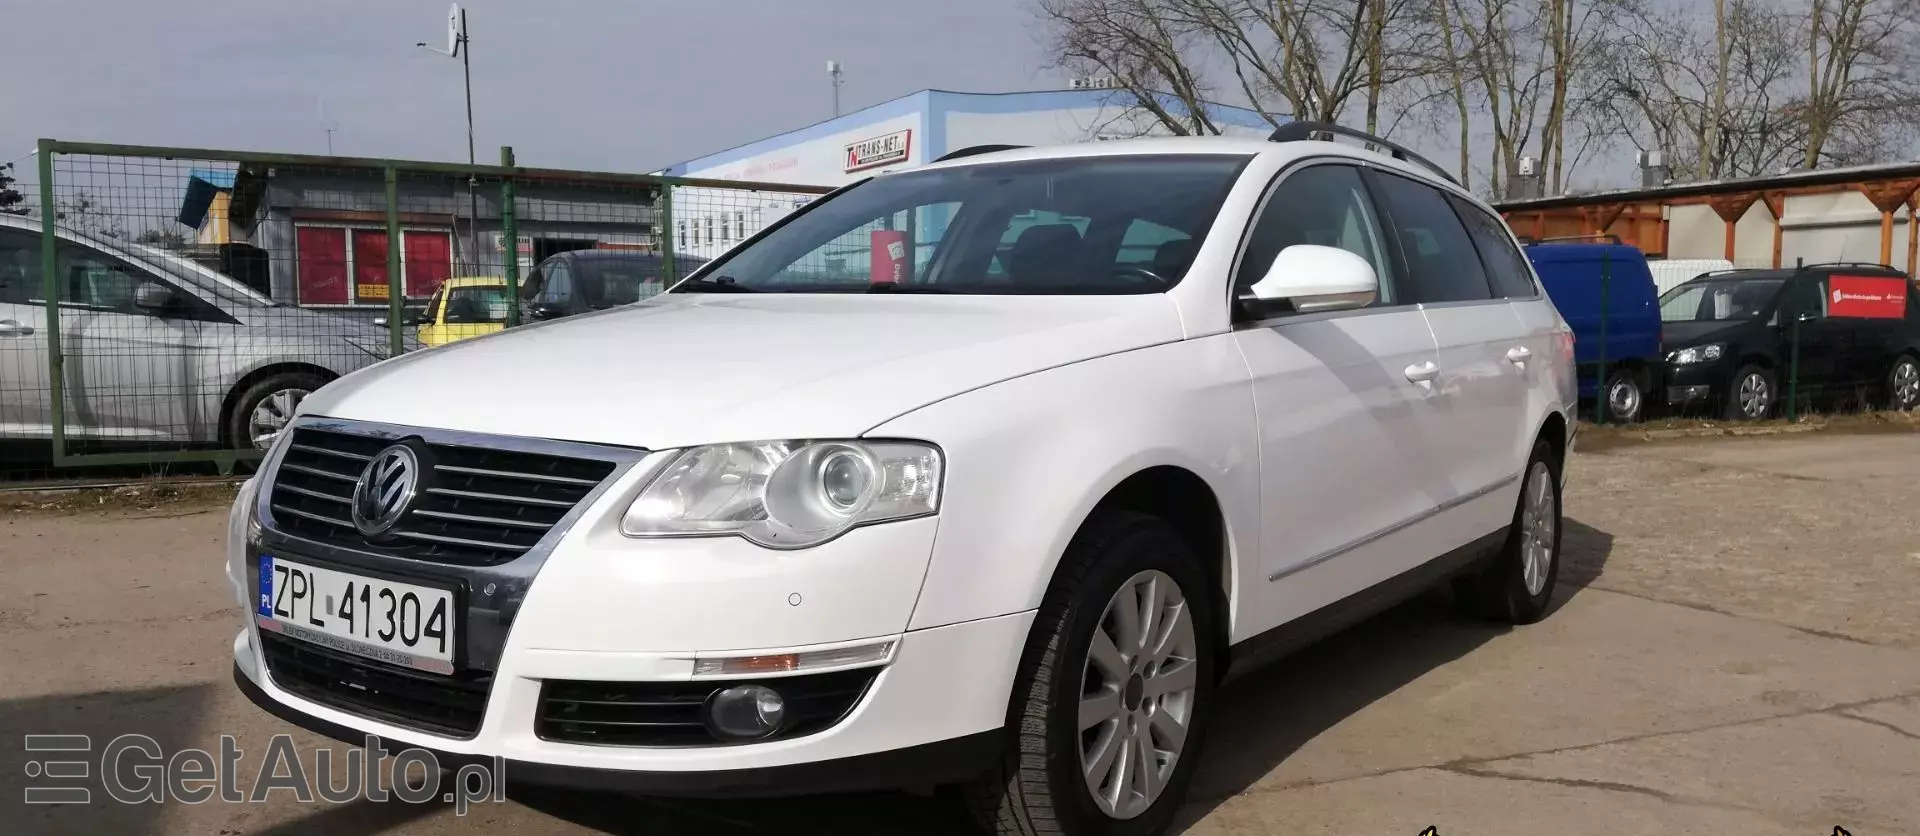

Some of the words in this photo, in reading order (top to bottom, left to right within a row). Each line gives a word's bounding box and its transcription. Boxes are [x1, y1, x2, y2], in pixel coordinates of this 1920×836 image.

[859, 136, 898, 159] TRANS-NET
[261, 594, 272, 609] PL
[274, 564, 325, 627] ZPL
[338, 581, 447, 654] 41304
